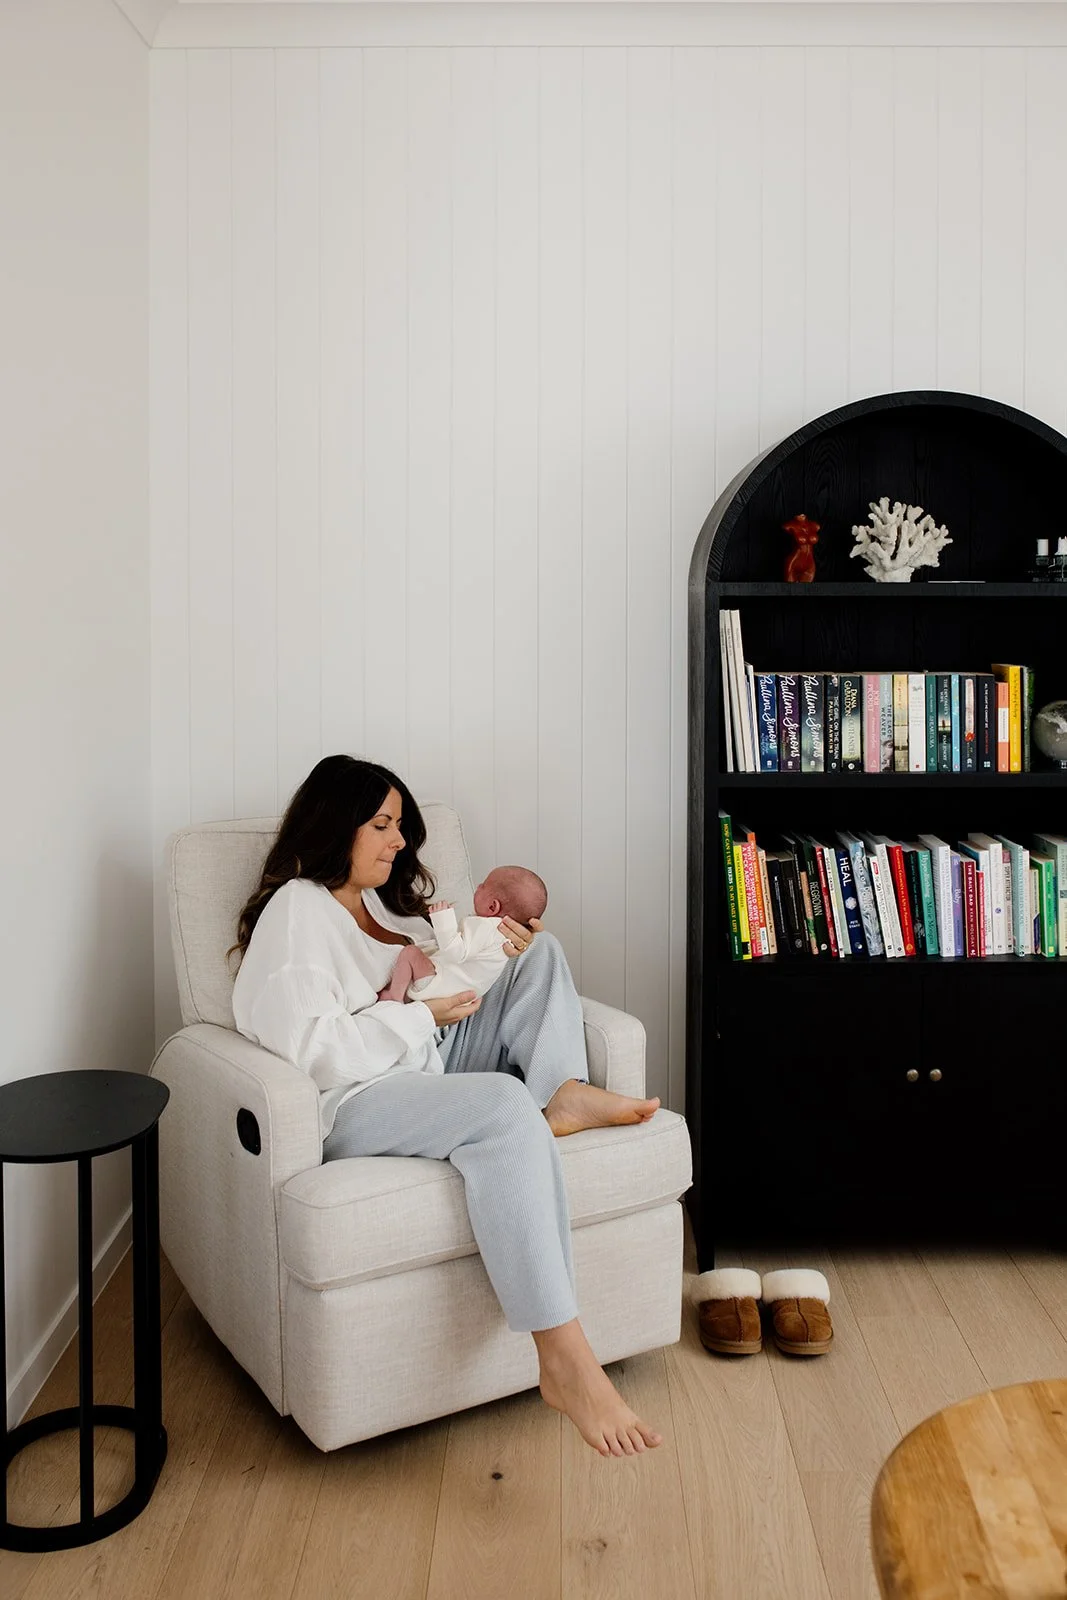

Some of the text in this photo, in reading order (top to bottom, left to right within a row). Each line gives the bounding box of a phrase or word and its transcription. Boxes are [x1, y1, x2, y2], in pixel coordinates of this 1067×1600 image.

[760, 675, 777, 749] Paullina Simons
[779, 675, 799, 757] Paullina Simons
[803, 675, 822, 757] Paullina Simons
[844, 680, 852, 717] GABALDON
[834, 722, 840, 730] ON
[840, 858, 852, 886] HEAL
[730, 893, 734, 901] MY
[809, 881, 822, 916] REGROWN
[927, 921, 935, 944] Mongan
